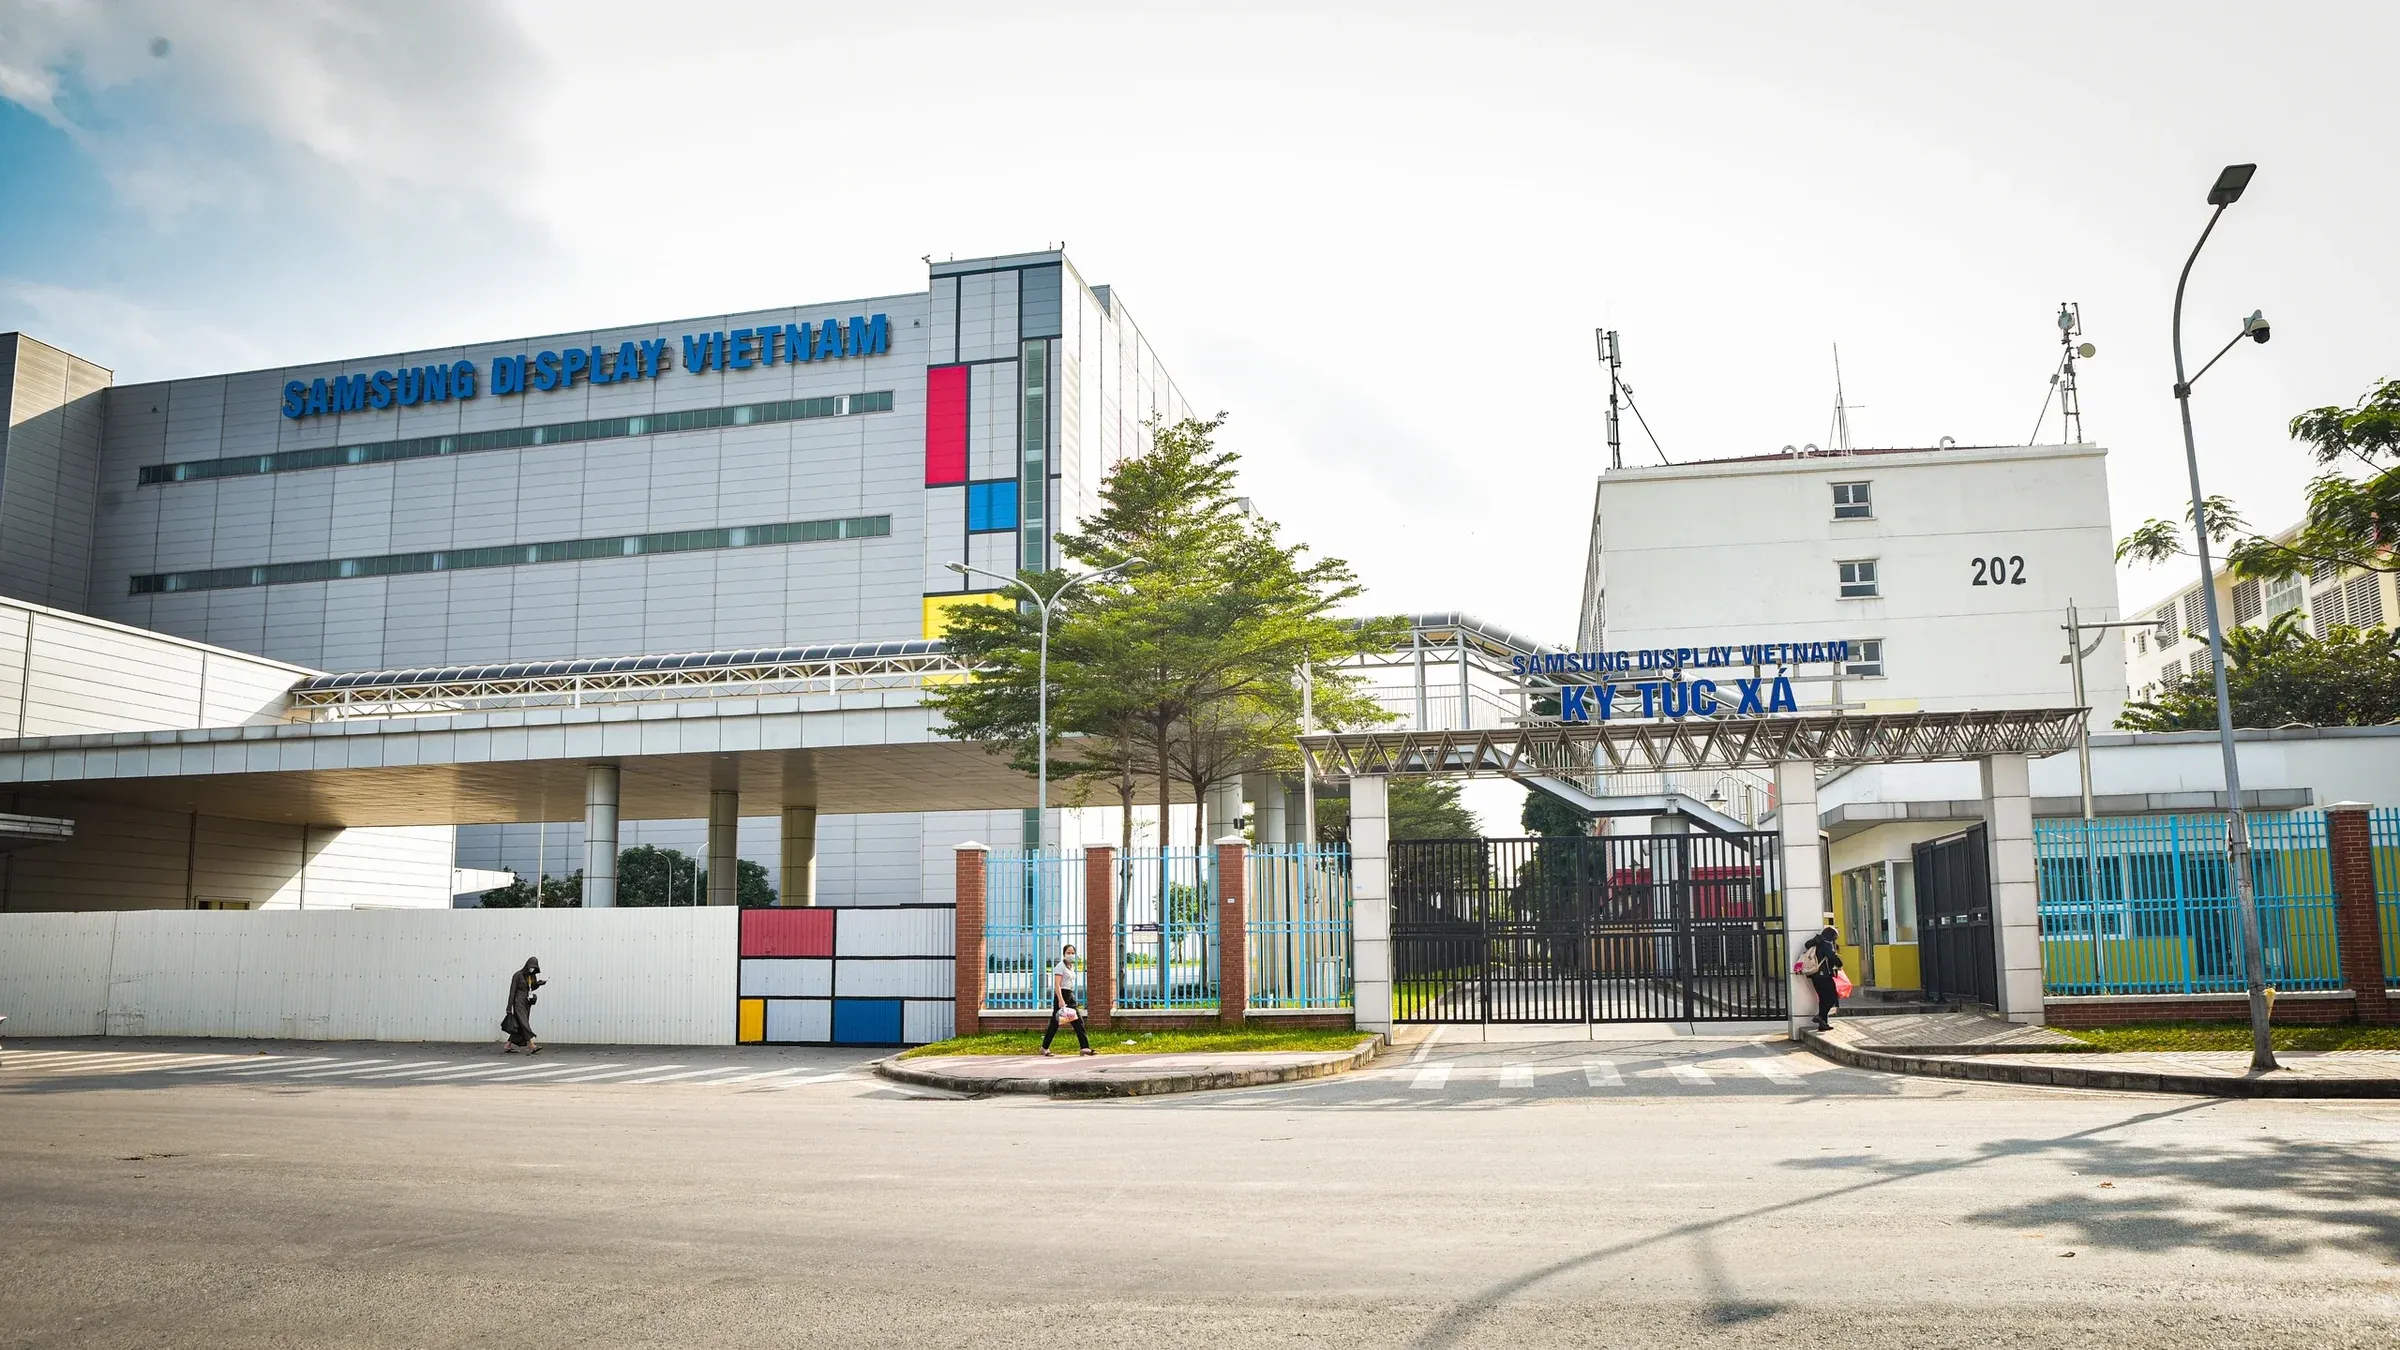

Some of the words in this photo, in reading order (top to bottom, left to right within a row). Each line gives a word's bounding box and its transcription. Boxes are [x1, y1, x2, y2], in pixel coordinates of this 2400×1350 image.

[282, 359, 475, 419] SAMSUNG
[490, 337, 668, 396] DISPLAY
[683, 313, 892, 374] VIETNAM
[1971, 555, 2026, 586] 202
[1511, 651, 1631, 677] SAMSUNG
[1638, 645, 1733, 671] DISPLAY
[1741, 640, 1850, 666] VIETNAM
[1561, 674, 1618, 722] KÝ
[1634, 671, 1719, 719] TÚC
[1735, 667, 1799, 715] XÁ
